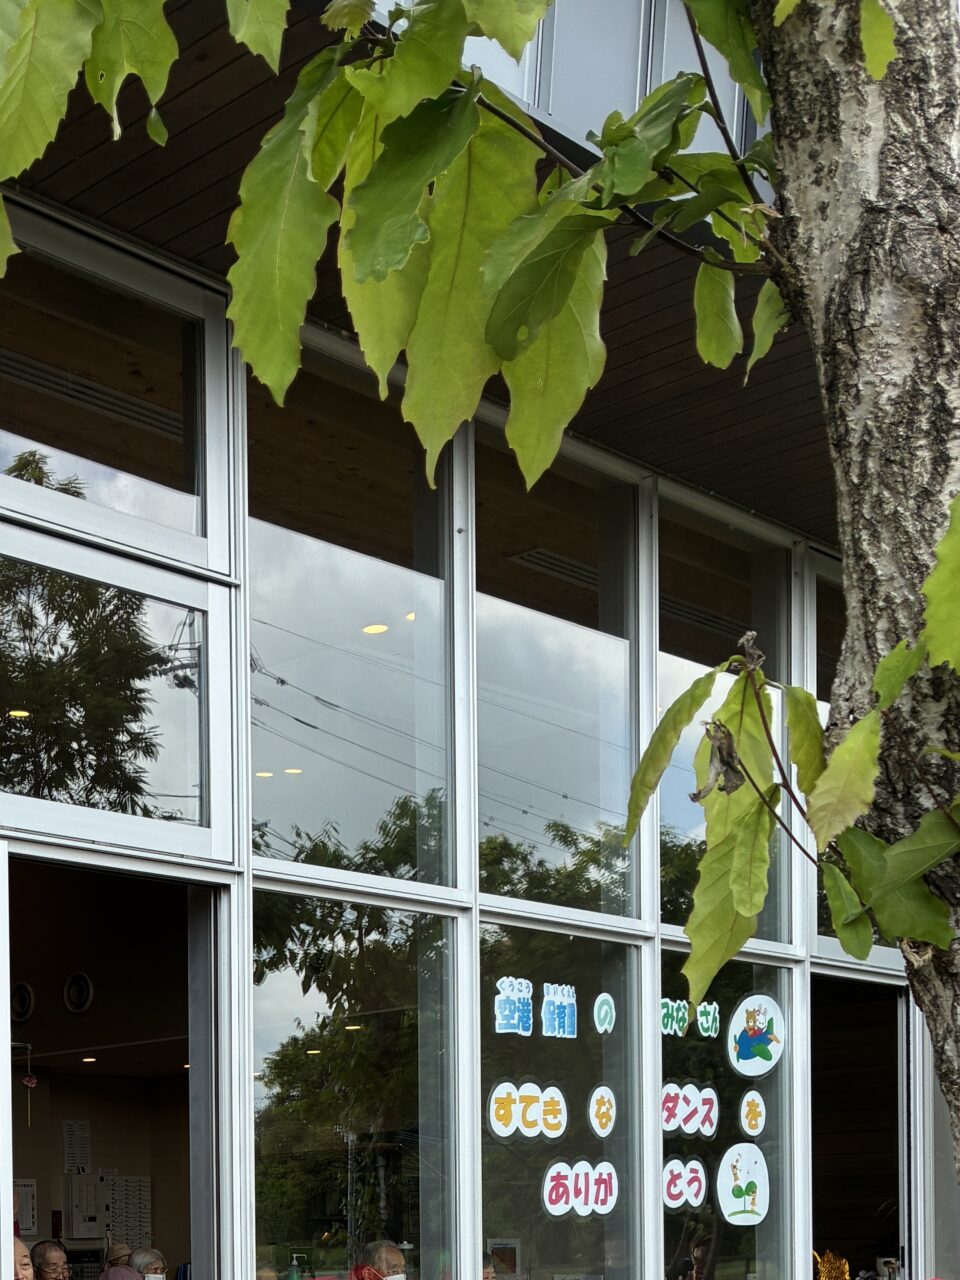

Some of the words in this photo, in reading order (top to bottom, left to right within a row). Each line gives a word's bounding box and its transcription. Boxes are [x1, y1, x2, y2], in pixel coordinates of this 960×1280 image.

[498, 996, 531, 1032] 空港
[597, 998, 614, 1027] の
[494, 1091, 562, 1132] すてき
[595, 1094, 614, 1130] な
[662, 1092, 714, 1129] ダンス
[745, 1098, 762, 1130] を
[548, 1171, 613, 1206] ありが
[666, 1167, 702, 1201] とう
